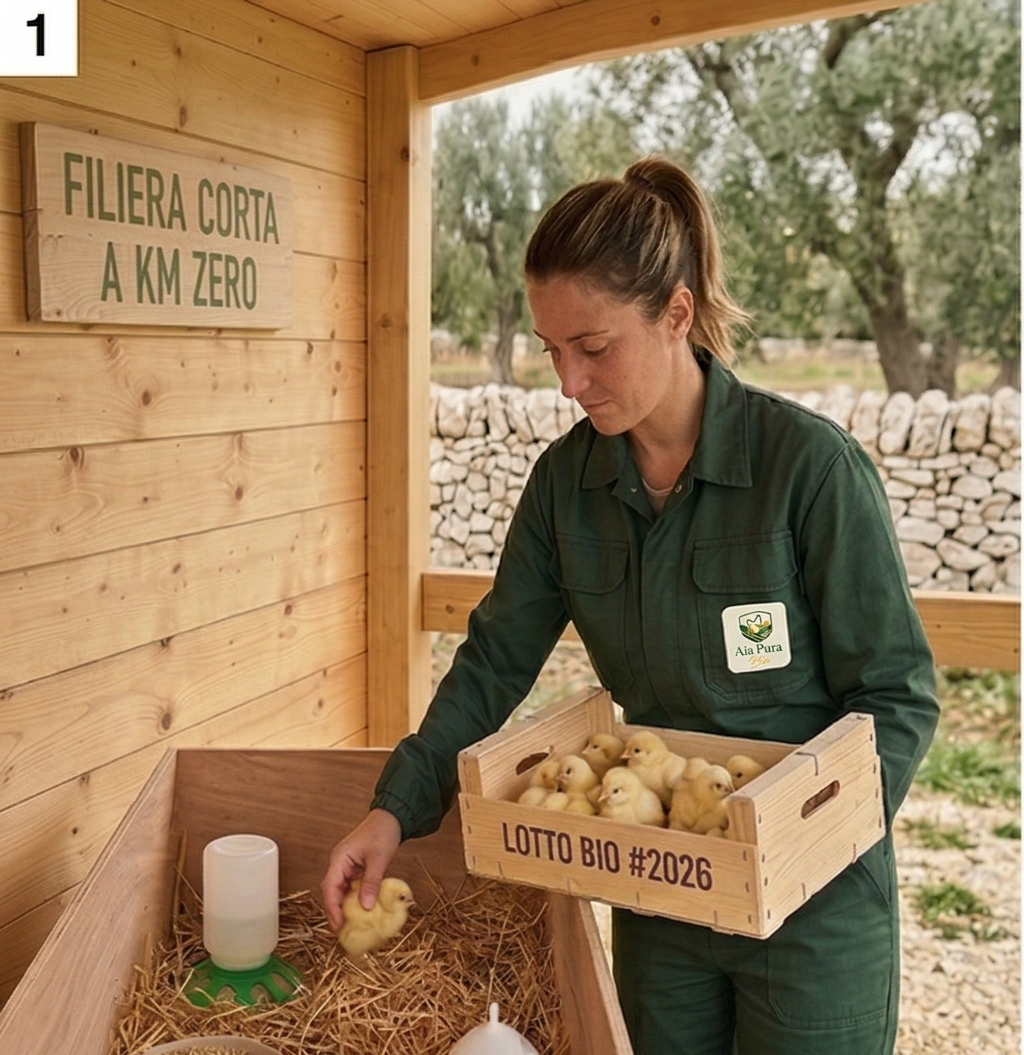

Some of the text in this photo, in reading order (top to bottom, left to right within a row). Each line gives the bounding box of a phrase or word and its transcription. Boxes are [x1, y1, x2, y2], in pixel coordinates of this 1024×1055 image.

[63, 151, 280, 245] FILIERA CORTA
[100, 241, 258, 311] A KM ZERO
[735, 643, 783, 657] Aia Pura
[502, 822, 713, 891] LOTTO BIO #2026
